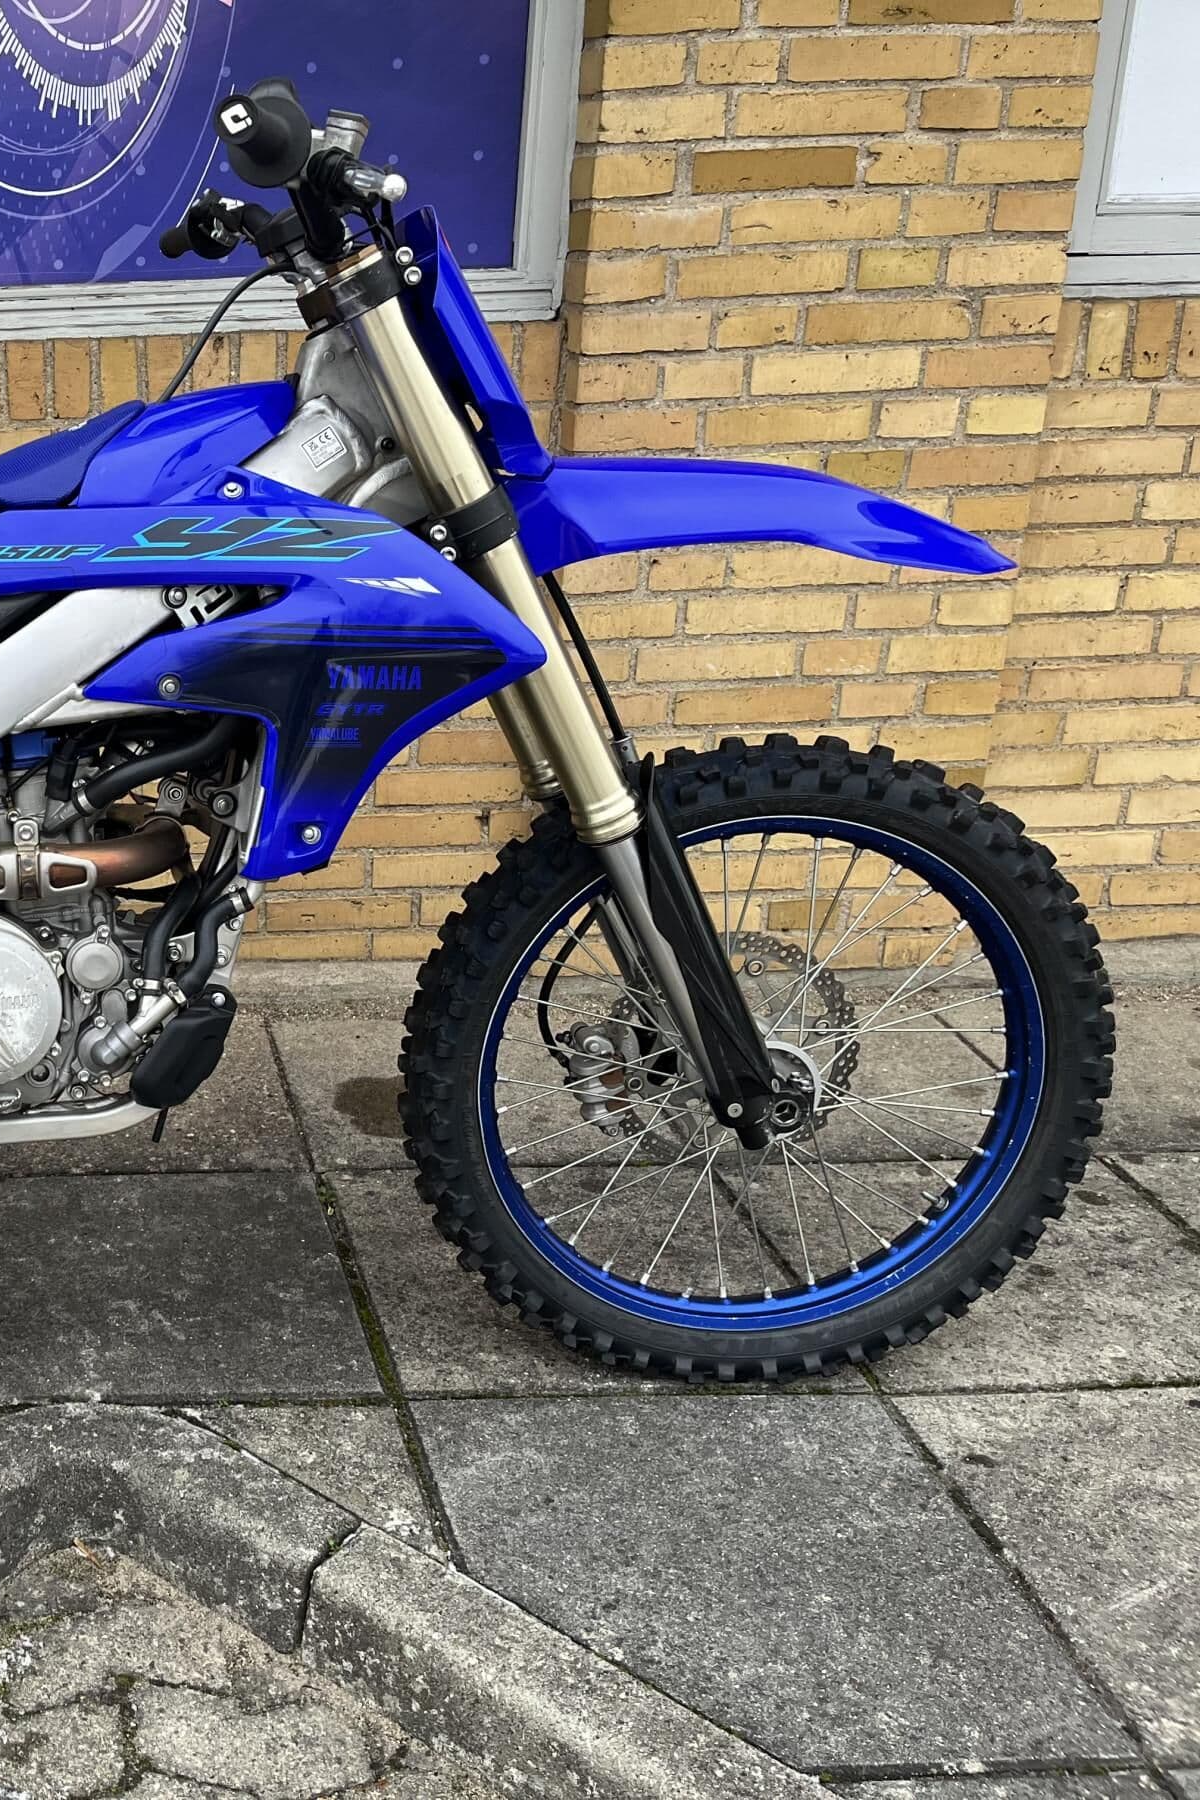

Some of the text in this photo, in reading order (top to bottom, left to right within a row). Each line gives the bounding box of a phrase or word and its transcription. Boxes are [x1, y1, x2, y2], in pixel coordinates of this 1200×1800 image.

[89, 516, 405, 563] YZ
[326, 664, 422, 690] YAMAHA
[309, 727, 360, 741] YAMALUBE
